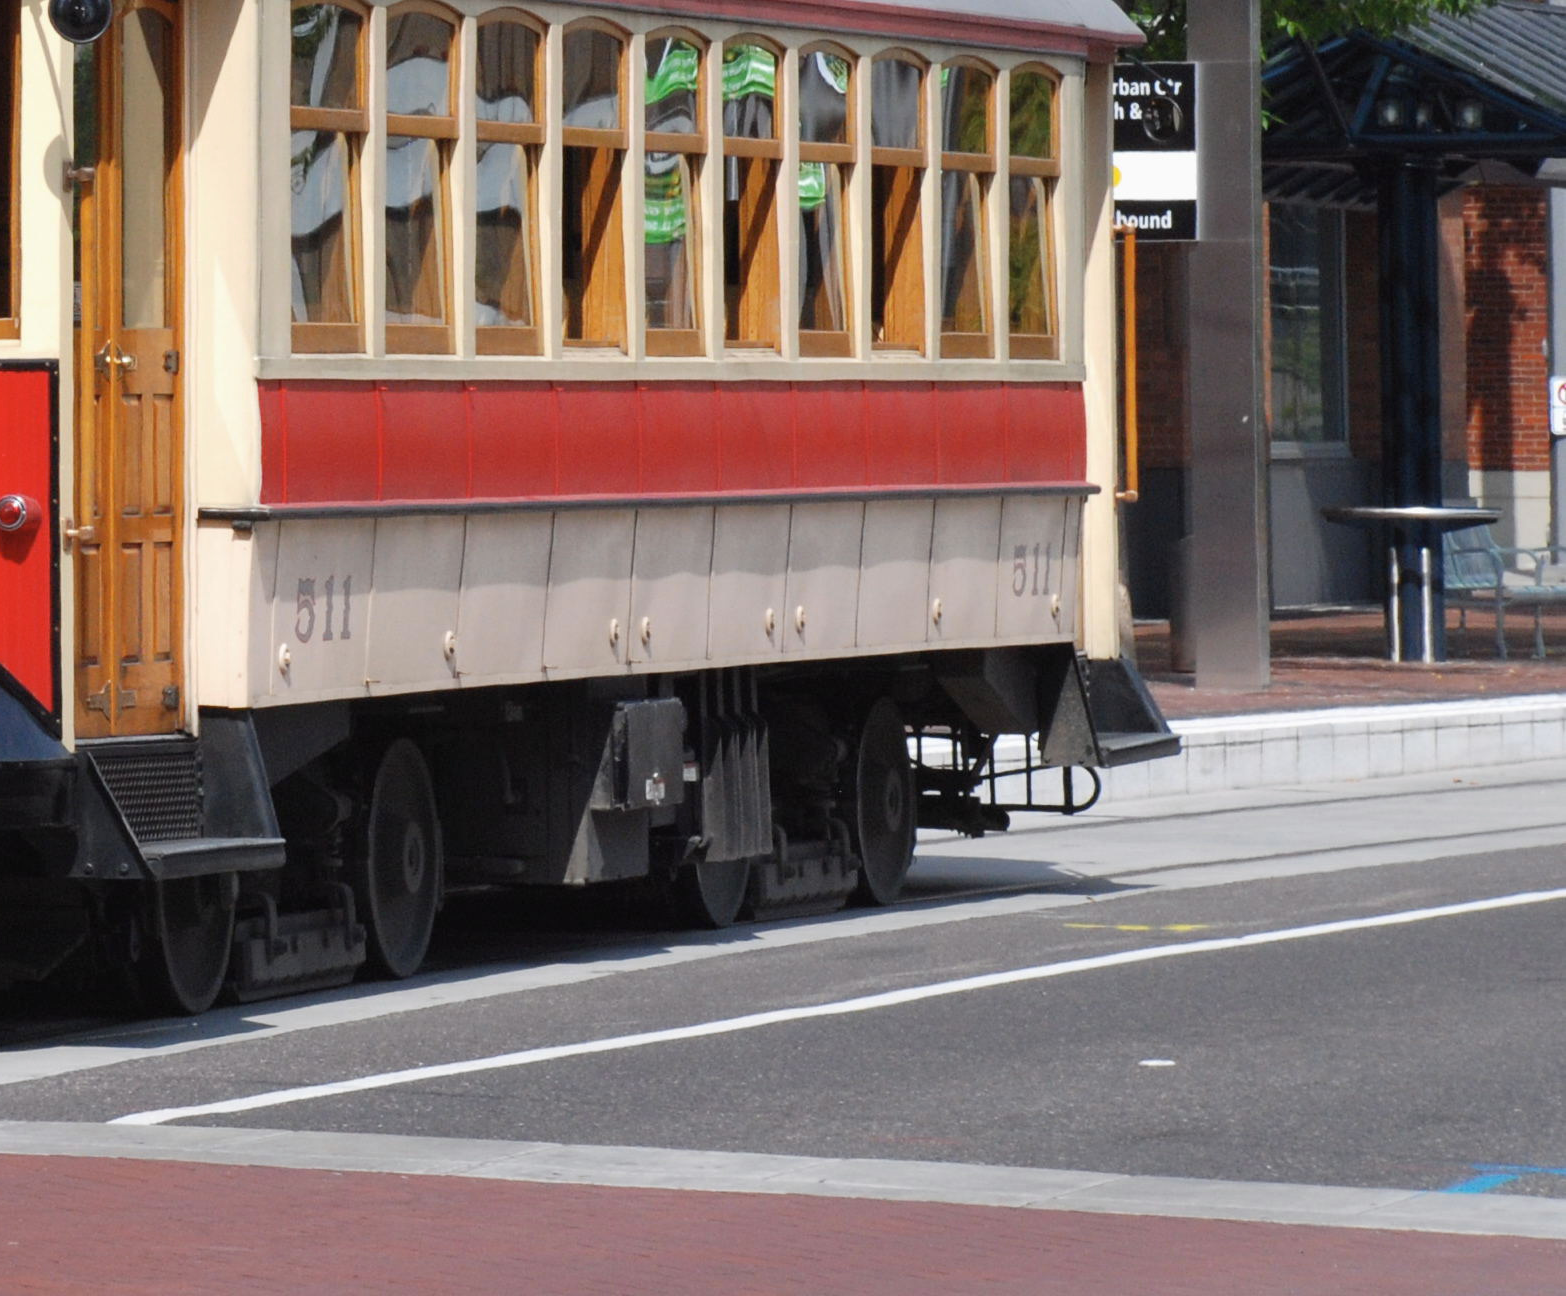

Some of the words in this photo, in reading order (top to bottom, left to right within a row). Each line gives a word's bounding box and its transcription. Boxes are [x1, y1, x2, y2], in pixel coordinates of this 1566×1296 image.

[1112, 77, 1151, 96] rban
[1154, 78, 1182, 96] Cr
[1129, 102, 1143, 120] &
[1115, 210, 1172, 229] bound
[1012, 542, 1054, 597] 511
[295, 573, 352, 645] 511
